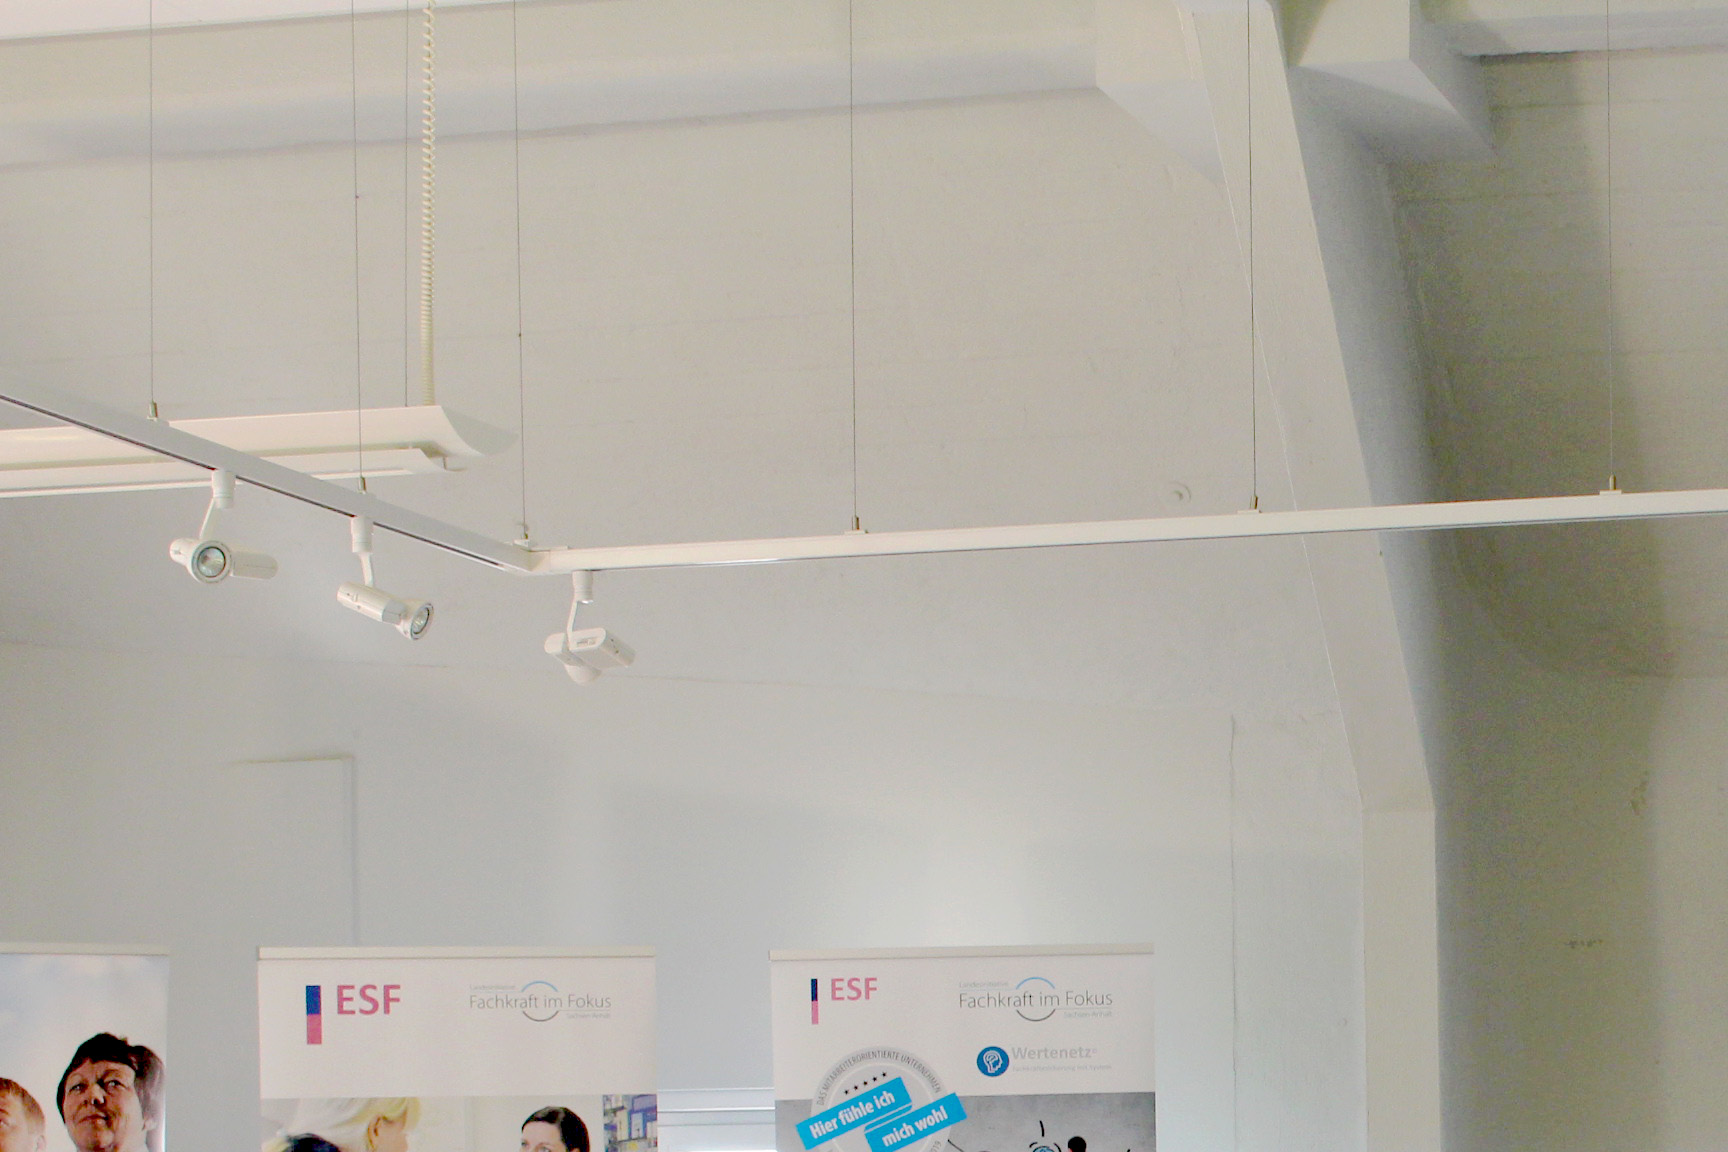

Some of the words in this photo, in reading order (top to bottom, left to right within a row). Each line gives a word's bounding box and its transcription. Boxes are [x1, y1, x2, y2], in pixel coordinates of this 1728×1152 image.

[337, 984, 401, 1015] ESF
[469, 994, 538, 1009] Fachkraft
[544, 994, 562, 1008] im
[568, 993, 611, 1008] Fokus
[830, 977, 878, 1001] ESF
[959, 991, 1034, 1008] Fachkraft
[1040, 992, 1059, 1006] im
[1066, 990, 1113, 1006] Fokus
[816, 1091, 827, 1106] DAS
[809, 1117, 839, 1139] Hier
[838, 1101, 874, 1126] fühle
[873, 1090, 896, 1110] ich
[882, 1121, 916, 1147] mich
[914, 1105, 948, 1128] wohl
